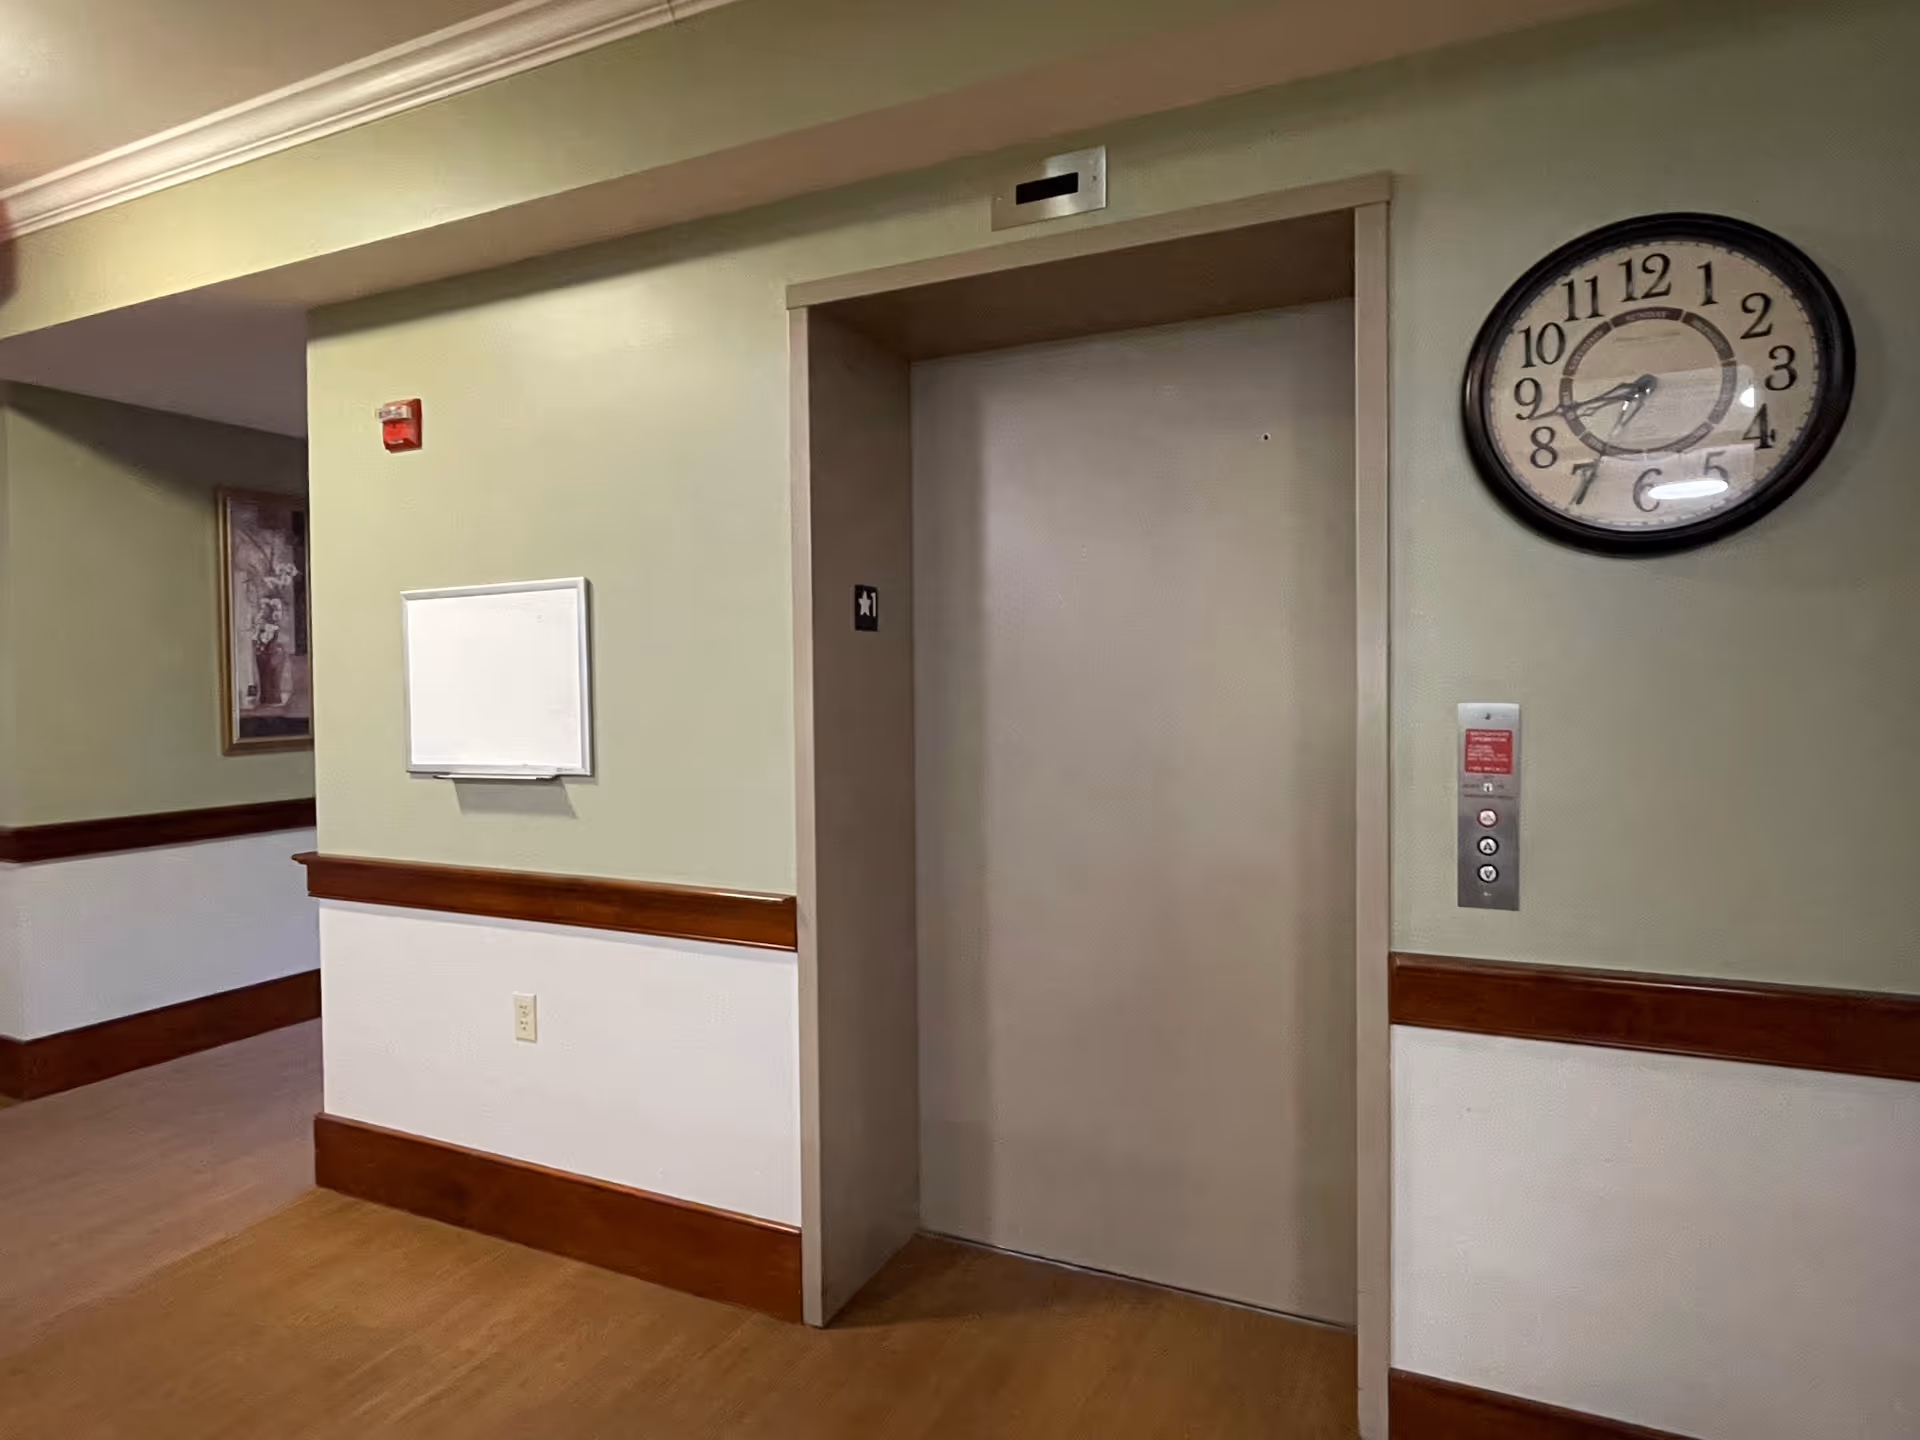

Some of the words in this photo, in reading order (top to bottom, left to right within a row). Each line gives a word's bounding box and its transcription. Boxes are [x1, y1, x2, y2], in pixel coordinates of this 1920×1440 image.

[1562, 276, 1603, 322] 11
[1618, 252, 1671, 302] 12
[1697, 261, 1719, 306] 1
[1740, 293, 1773, 339] 2
[1520, 322, 1566, 368] 10
[1765, 345, 1797, 391] 3
[1514, 377, 1541, 420] 9
[1530, 426, 1558, 469] 8
[1742, 404, 1776, 450] 4
[1571, 462, 1598, 505] 7
[1703, 450, 1729, 484] 5
[1633, 468, 1662, 512] 6
[870, 592, 877, 617] 1
